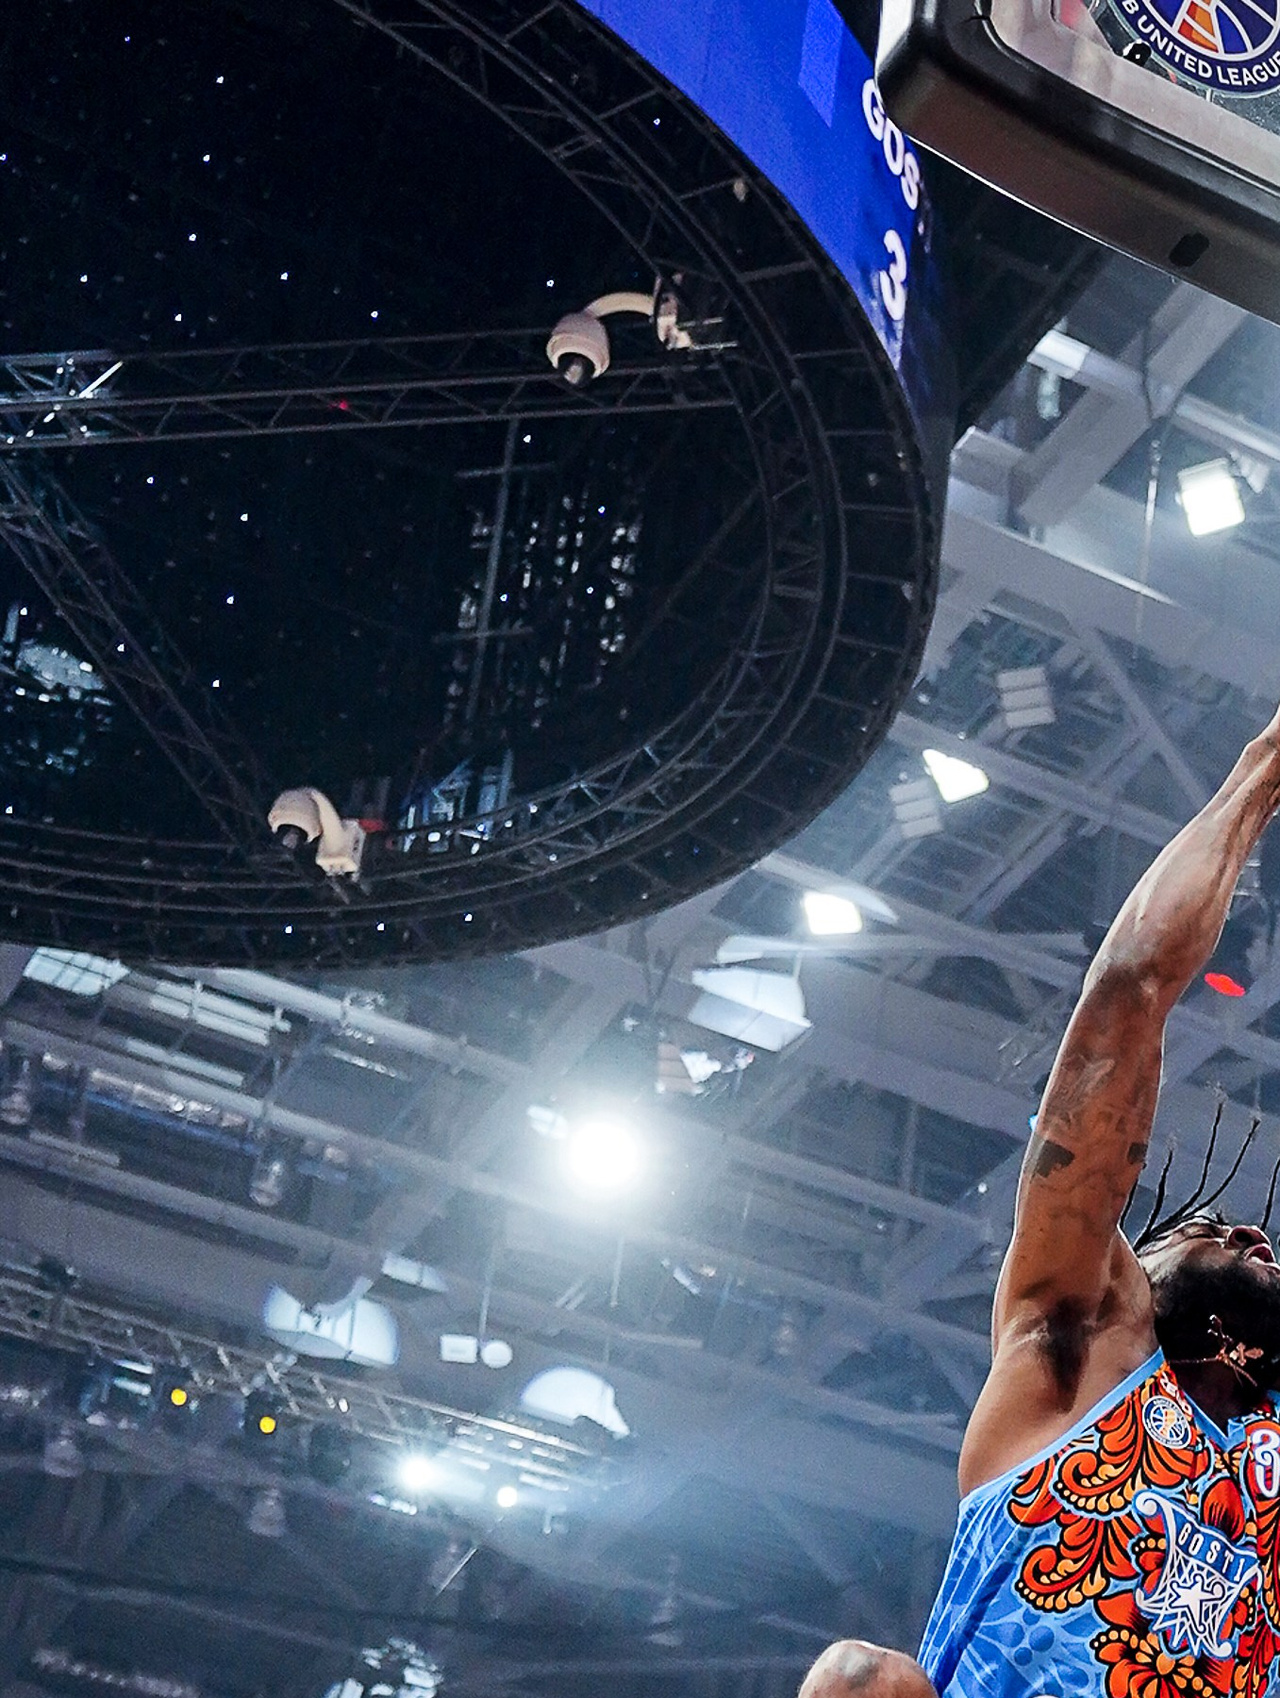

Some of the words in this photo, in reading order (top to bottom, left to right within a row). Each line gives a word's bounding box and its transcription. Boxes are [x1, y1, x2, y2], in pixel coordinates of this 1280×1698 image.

[1138, 15, 1213, 78] UNITED
[879, 229, 908, 321] 3
[1177, 1522, 1246, 1581] GOSTI
